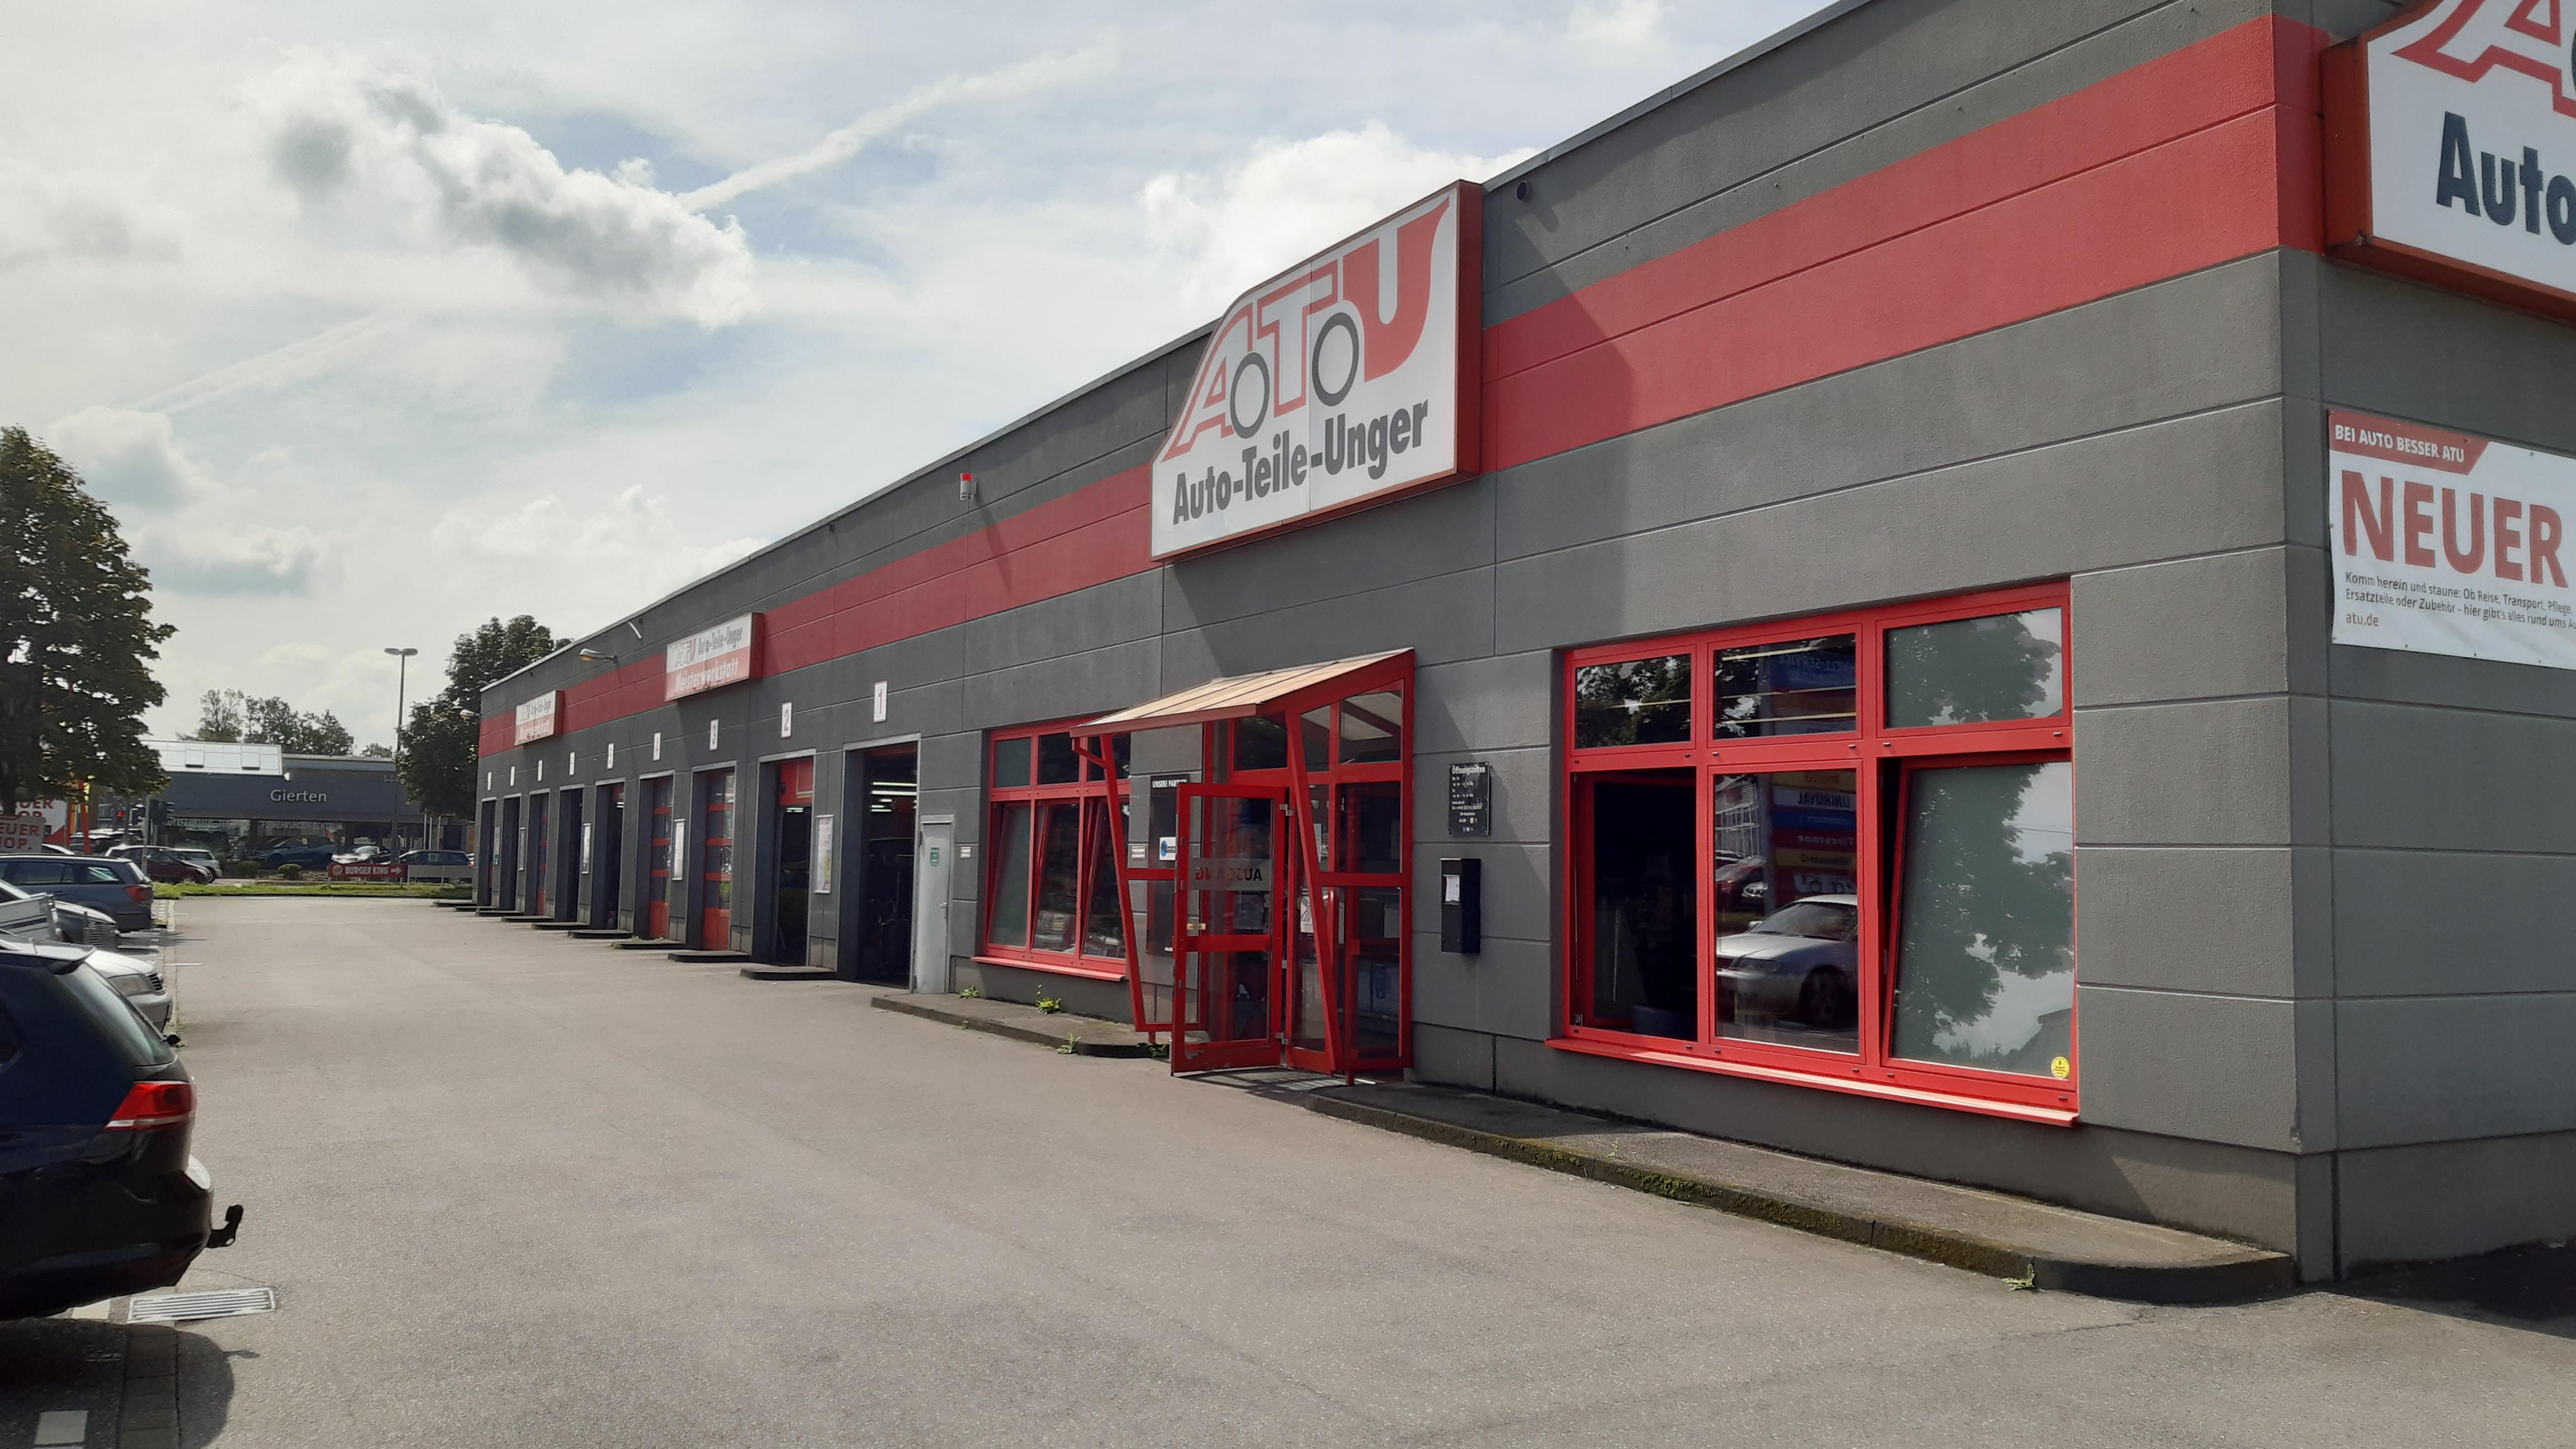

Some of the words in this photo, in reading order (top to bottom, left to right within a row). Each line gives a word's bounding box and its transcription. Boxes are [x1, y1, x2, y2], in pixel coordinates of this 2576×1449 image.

[2335, 424, 2355, 442] BEI
[2359, 430, 2393, 449] AUTO
[2397, 437, 2440, 458] BESSER
[2442, 446, 2464, 463] ATU
[1173, 399, 1428, 525] Auto-Teile-Unger
[2342, 470, 2569, 589] NEUER
[2346, 571, 2375, 586] Komm
[2377, 576, 2407, 591] herein
[2411, 583, 2427, 593] und
[2428, 586, 2461, 599] staune:
[2463, 589, 2475, 600] Ob
[2478, 590, 2501, 605] Reise,
[2503, 594, 2546, 611] Transport,
[2548, 601, 2573, 617] Pflege,
[2346, 589, 2394, 605] Ersatzteile
[2396, 596, 2417, 608] oder
[2418, 598, 2455, 613] Zubehör
[2464, 604, 2482, 617] hier
[2483, 607, 2506, 621] gibt's
[2508, 610, 2525, 623] alles
[2527, 615, 2546, 626] rund
[2549, 619, 2566, 628] ums
[2346, 613, 2379, 627] atu.de
[674, 657, 739, 693] Meisterwerkstatt
[878, 688, 883, 714] 1
[711, 725, 716, 745] 3
[783, 708, 789, 732] 2
[270, 789, 326, 802] Gierten
[345, 866, 372, 875] BURGER
[372, 866, 389, 875] KING
